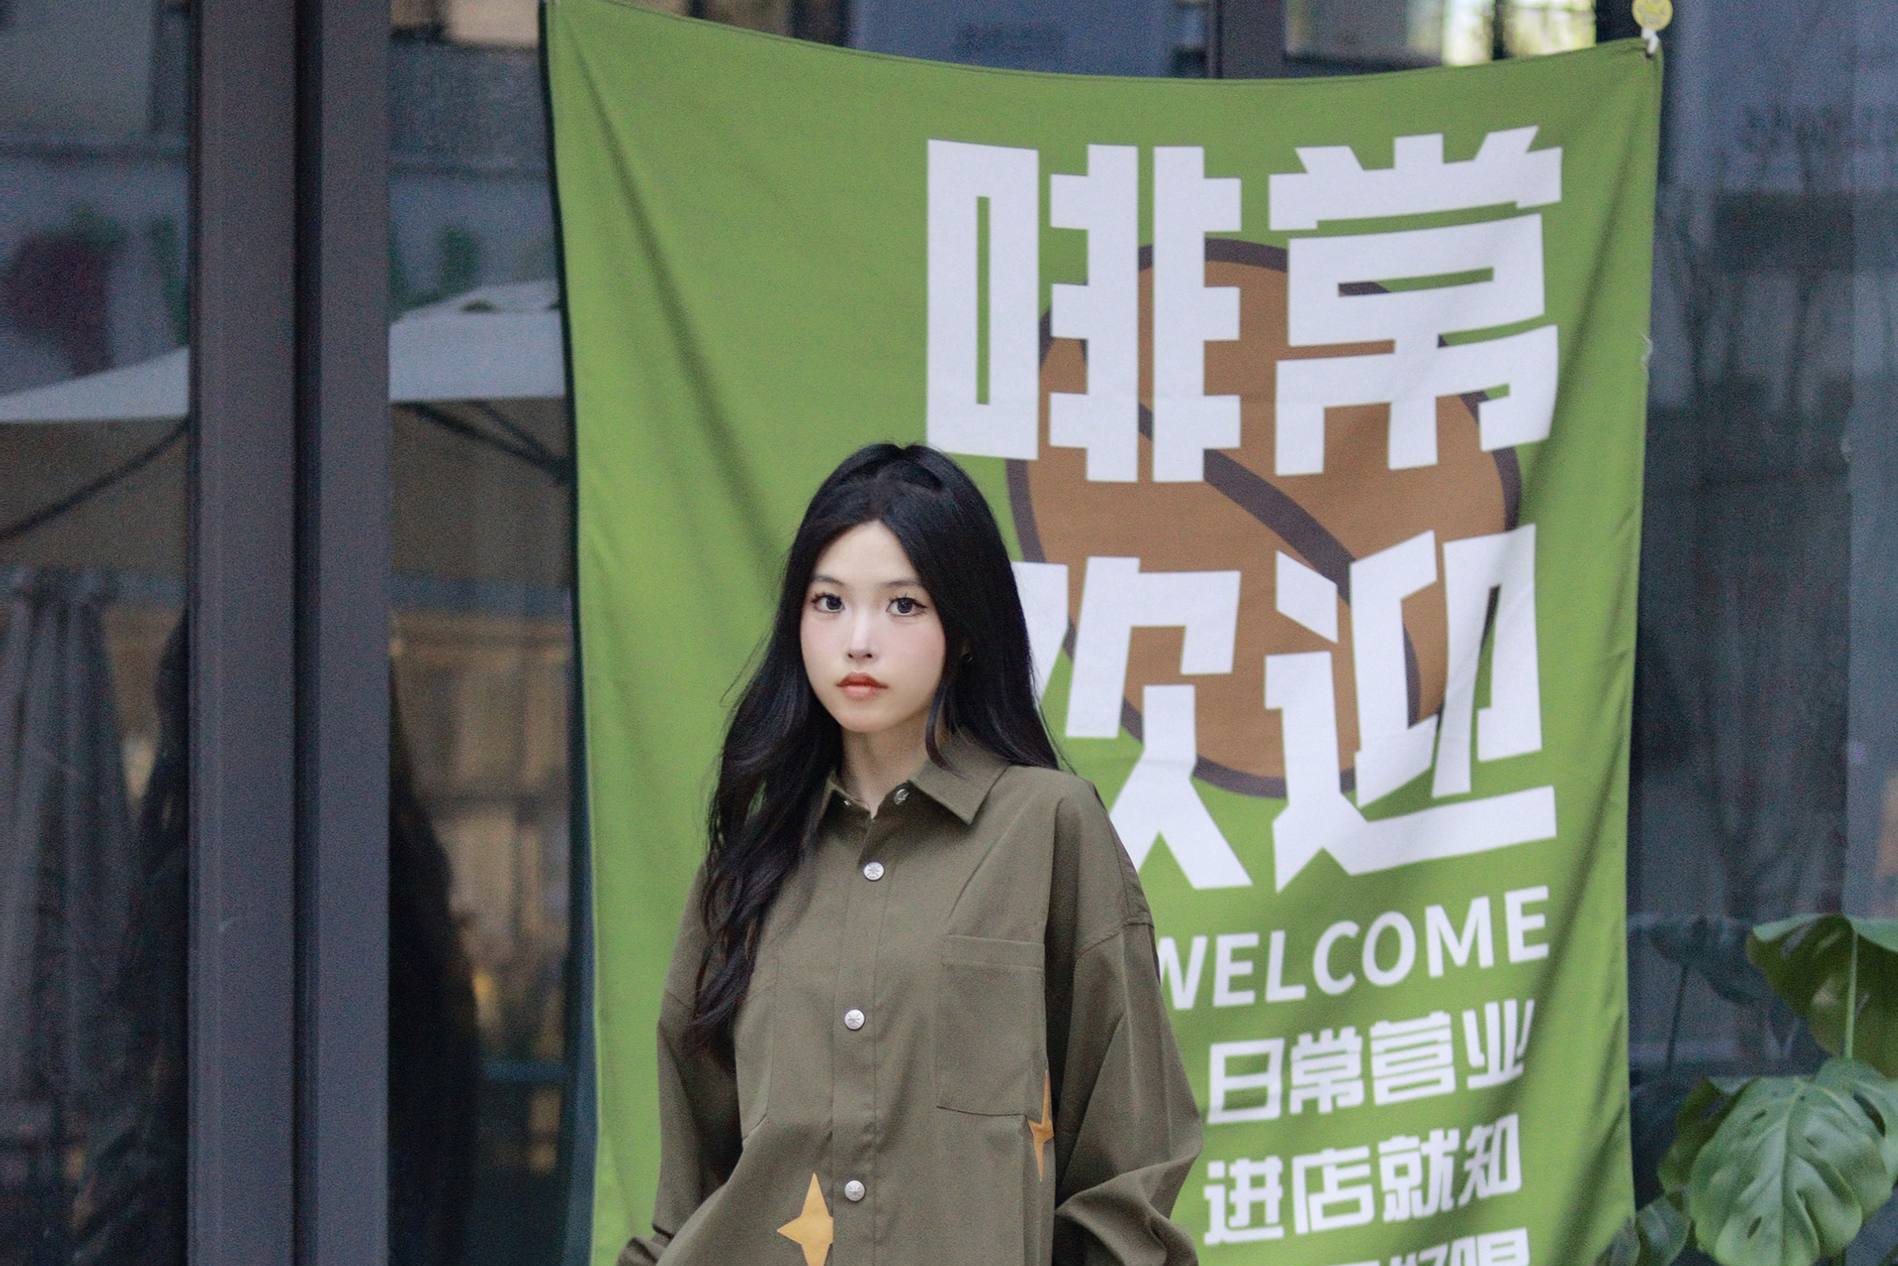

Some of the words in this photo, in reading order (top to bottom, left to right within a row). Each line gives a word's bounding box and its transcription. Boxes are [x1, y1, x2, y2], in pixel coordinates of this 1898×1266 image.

[927, 126, 1562, 482] 啡常
[1011, 523, 1557, 893] 欢迎
[1157, 885, 1550, 1010] WELCOME
[1207, 999, 1535, 1124] 日常营业
[1204, 1114, 1522, 1245] 进店就知
